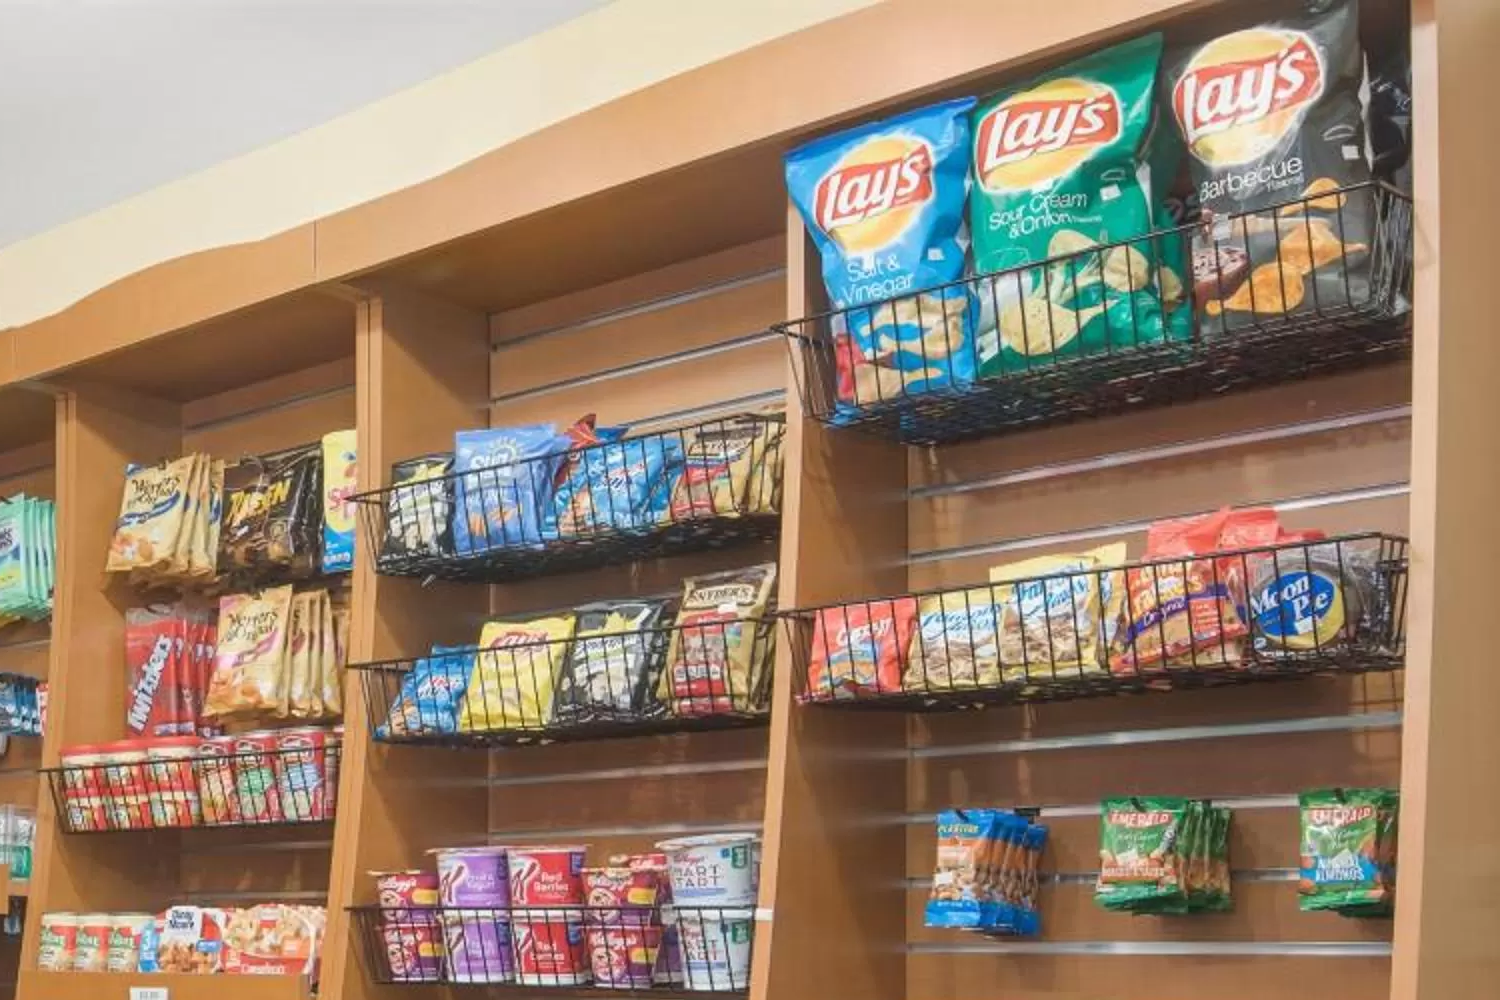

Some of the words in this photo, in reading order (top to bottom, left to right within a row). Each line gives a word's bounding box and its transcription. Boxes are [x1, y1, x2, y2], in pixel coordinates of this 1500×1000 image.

[1183, 48, 1307, 142] Lay's
[984, 98, 1112, 172] Lay's
[823, 153, 925, 229] Lay's
[989, 205, 1026, 231] Sour
[1029, 193, 1088, 213] Cream
[841, 272, 914, 303] Vinegar
[1291, 591, 1329, 621] Pe
